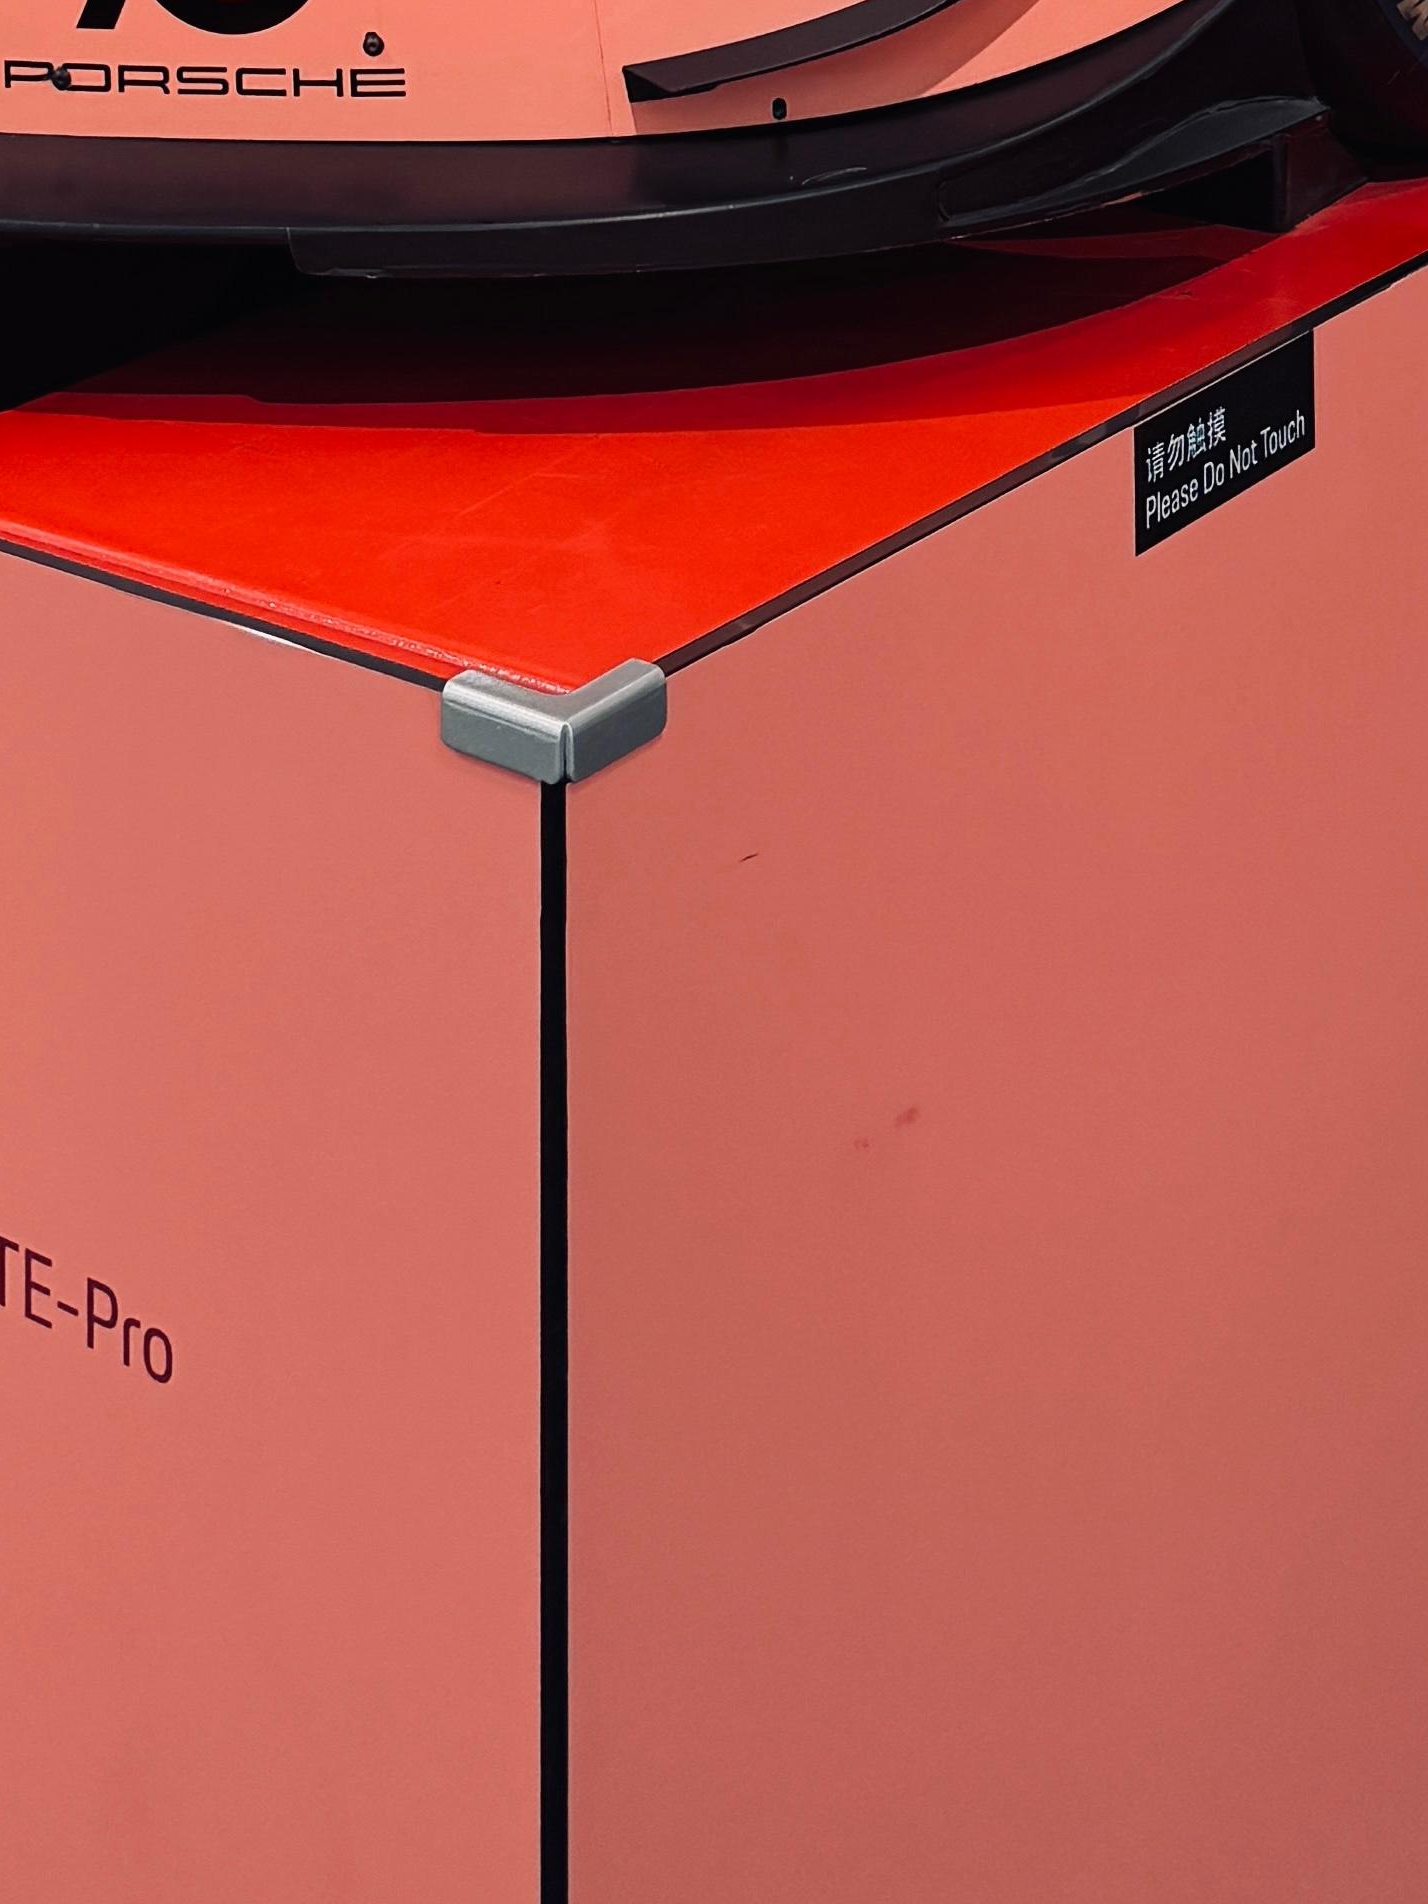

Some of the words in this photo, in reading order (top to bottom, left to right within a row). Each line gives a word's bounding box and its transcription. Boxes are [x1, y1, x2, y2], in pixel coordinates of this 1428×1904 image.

[4, 59, 406, 98] PORSCHE
[1146, 406, 1227, 483] 请勿触摸
[1146, 478, 1199, 529] Please
[1204, 461, 1225, 494] Do
[1229, 439, 1258, 479] Not
[1260, 409, 1305, 458] Touch
